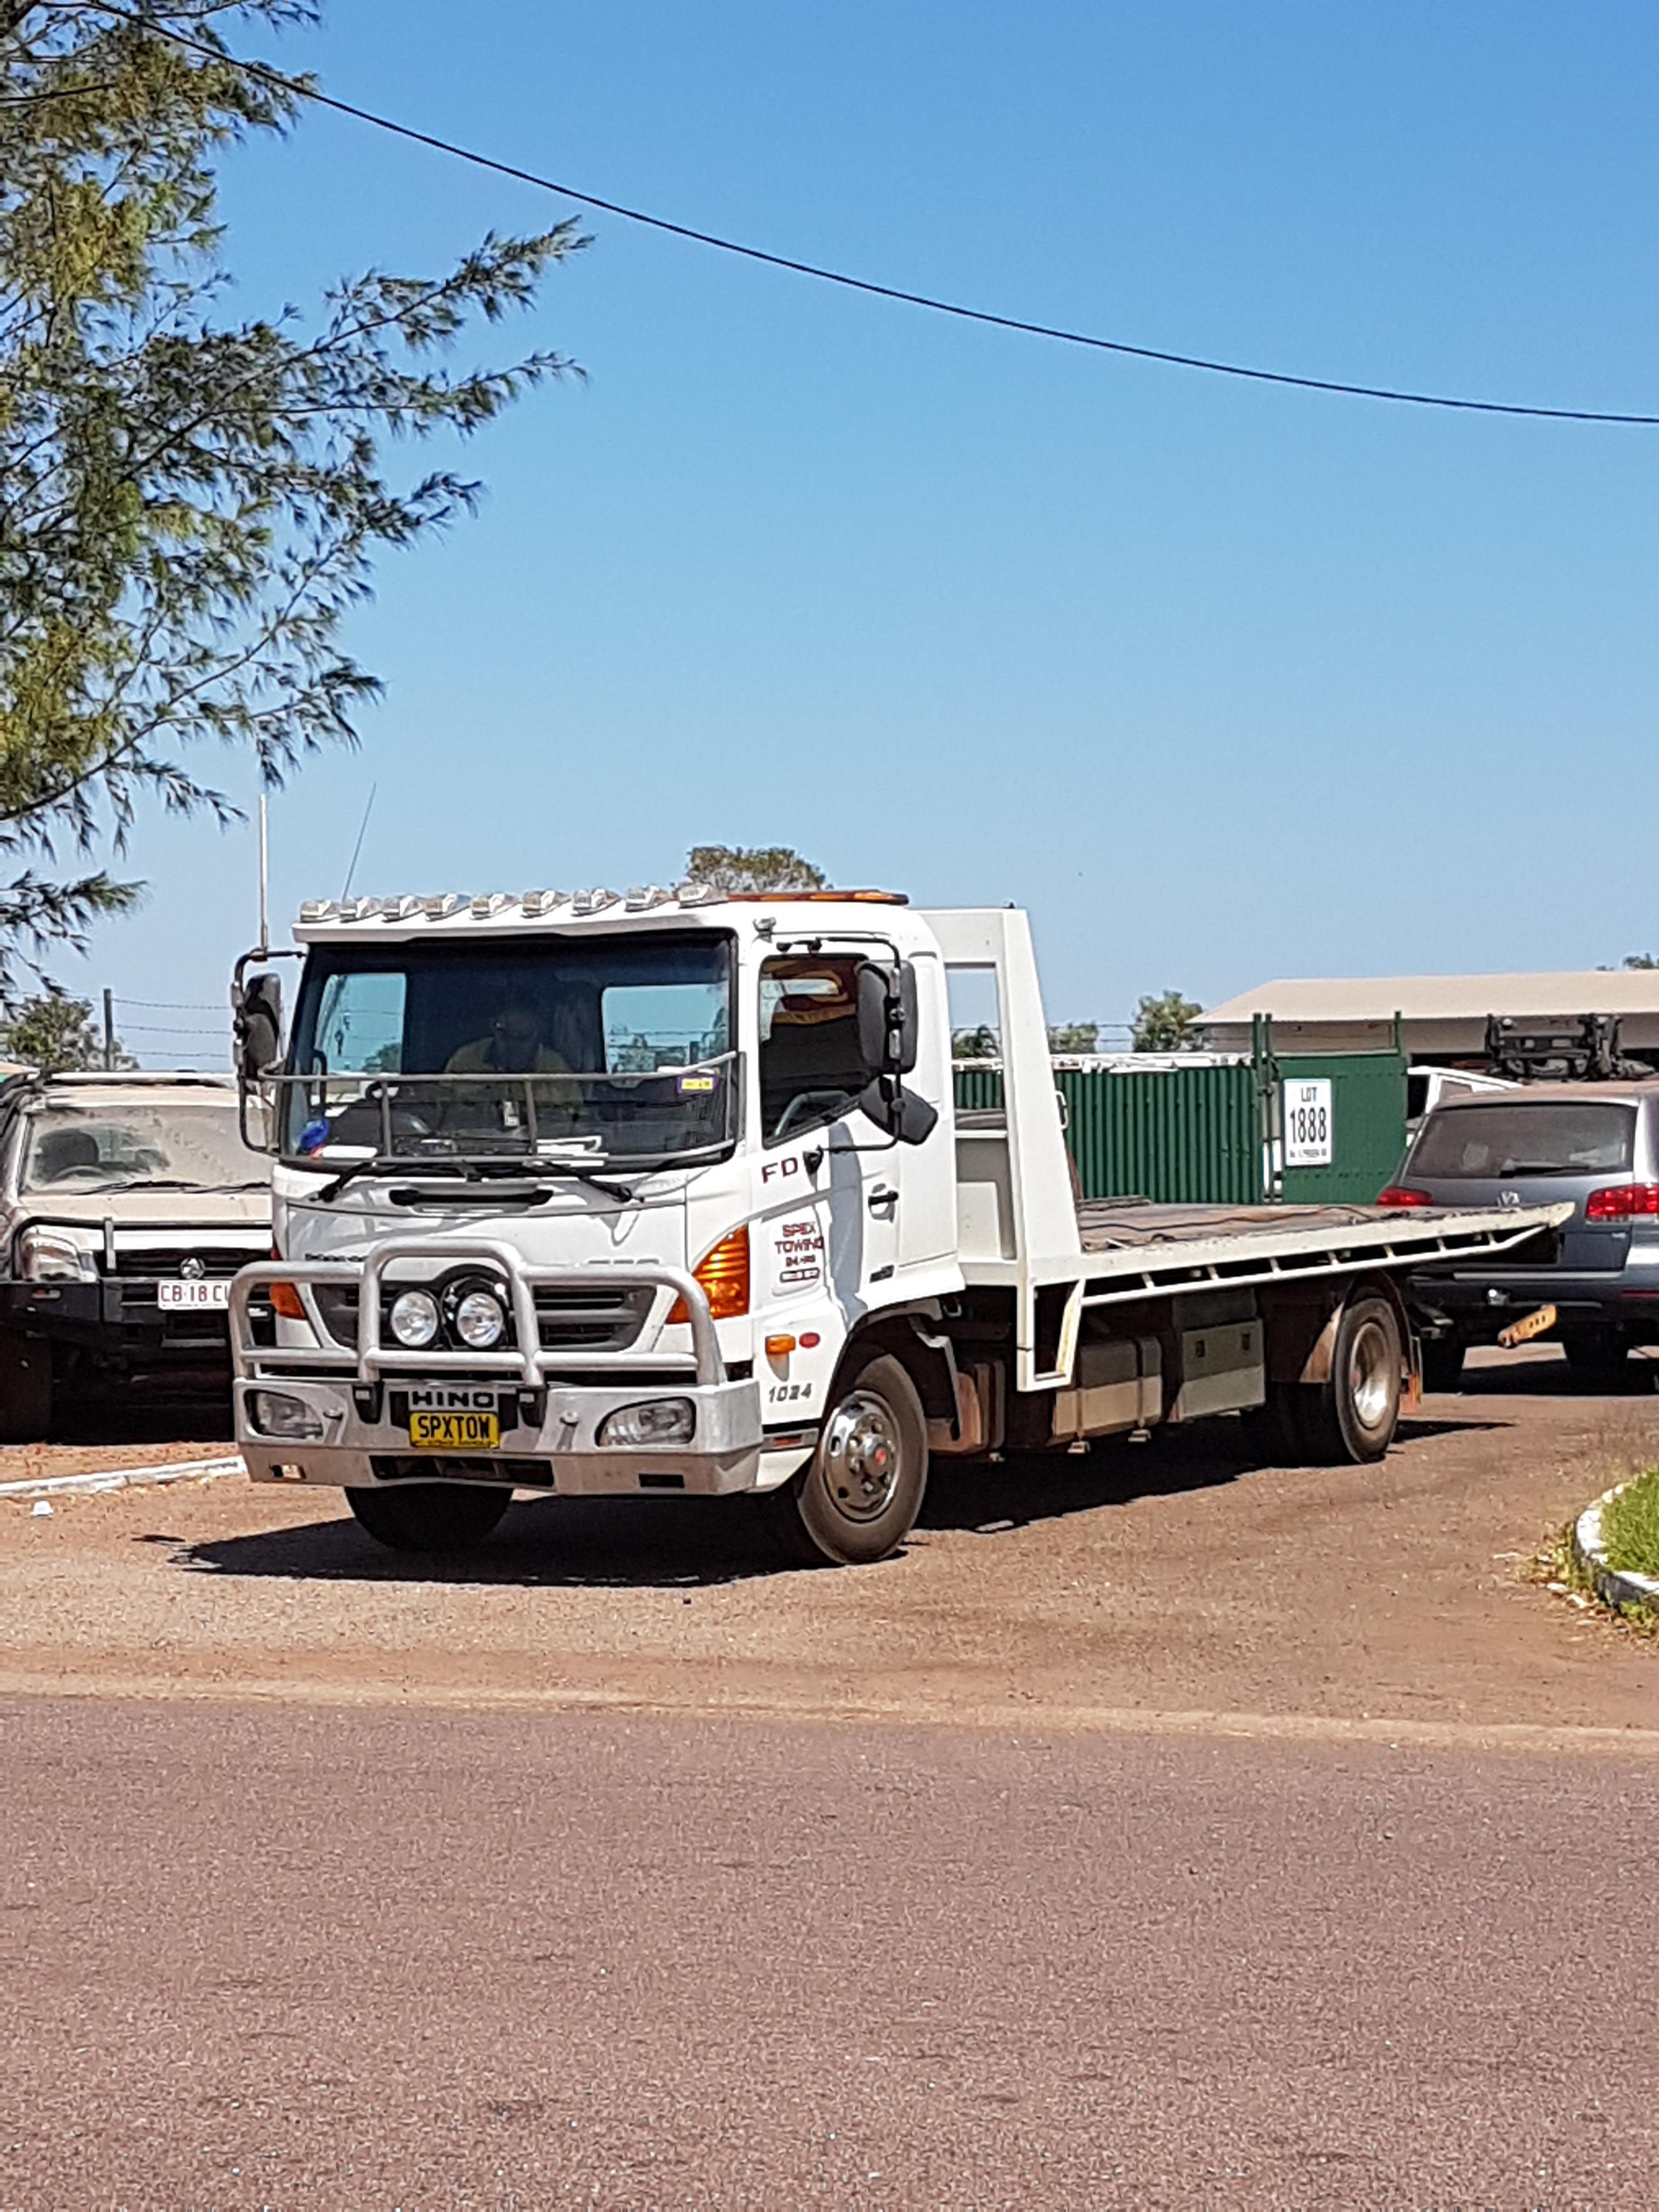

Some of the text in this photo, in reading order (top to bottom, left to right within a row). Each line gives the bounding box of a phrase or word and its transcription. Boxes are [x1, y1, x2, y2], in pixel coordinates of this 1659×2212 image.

[1301, 1087, 1317, 1102] LOT
[1290, 1107, 1327, 1144] 1888
[761, 1156, 798, 1184] FD
[412, 1391, 494, 1408] HINO
[769, 1383, 812, 1403] 1024
[417, 1415, 490, 1440] SPXTOW
